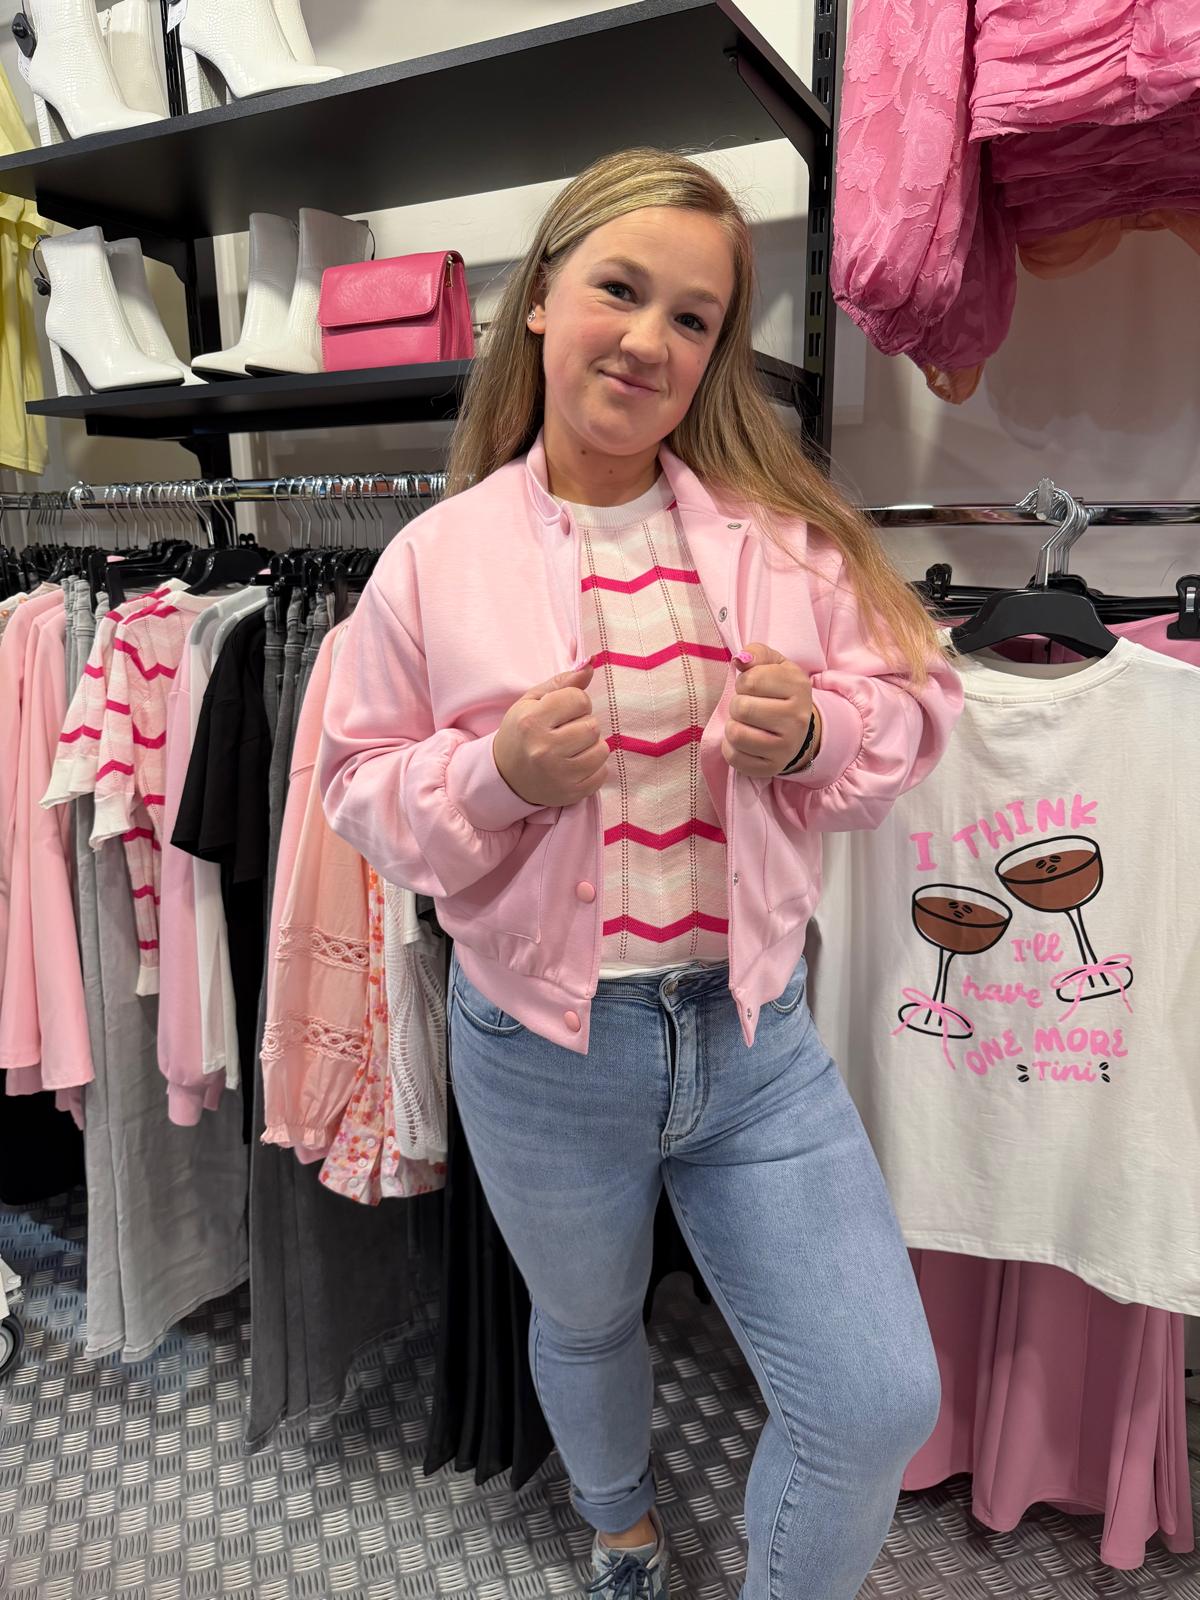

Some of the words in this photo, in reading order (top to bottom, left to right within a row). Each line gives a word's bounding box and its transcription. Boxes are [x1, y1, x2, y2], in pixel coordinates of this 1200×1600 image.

[909, 831, 938, 872] I
[951, 793, 1098, 859] THINK
[1010, 932, 1064, 964] I'll
[961, 975, 1044, 1009] have
[964, 1029, 1024, 1077] ONE
[1033, 1026, 1129, 1058] MORE
[1031, 1059, 1098, 1083] Tini
